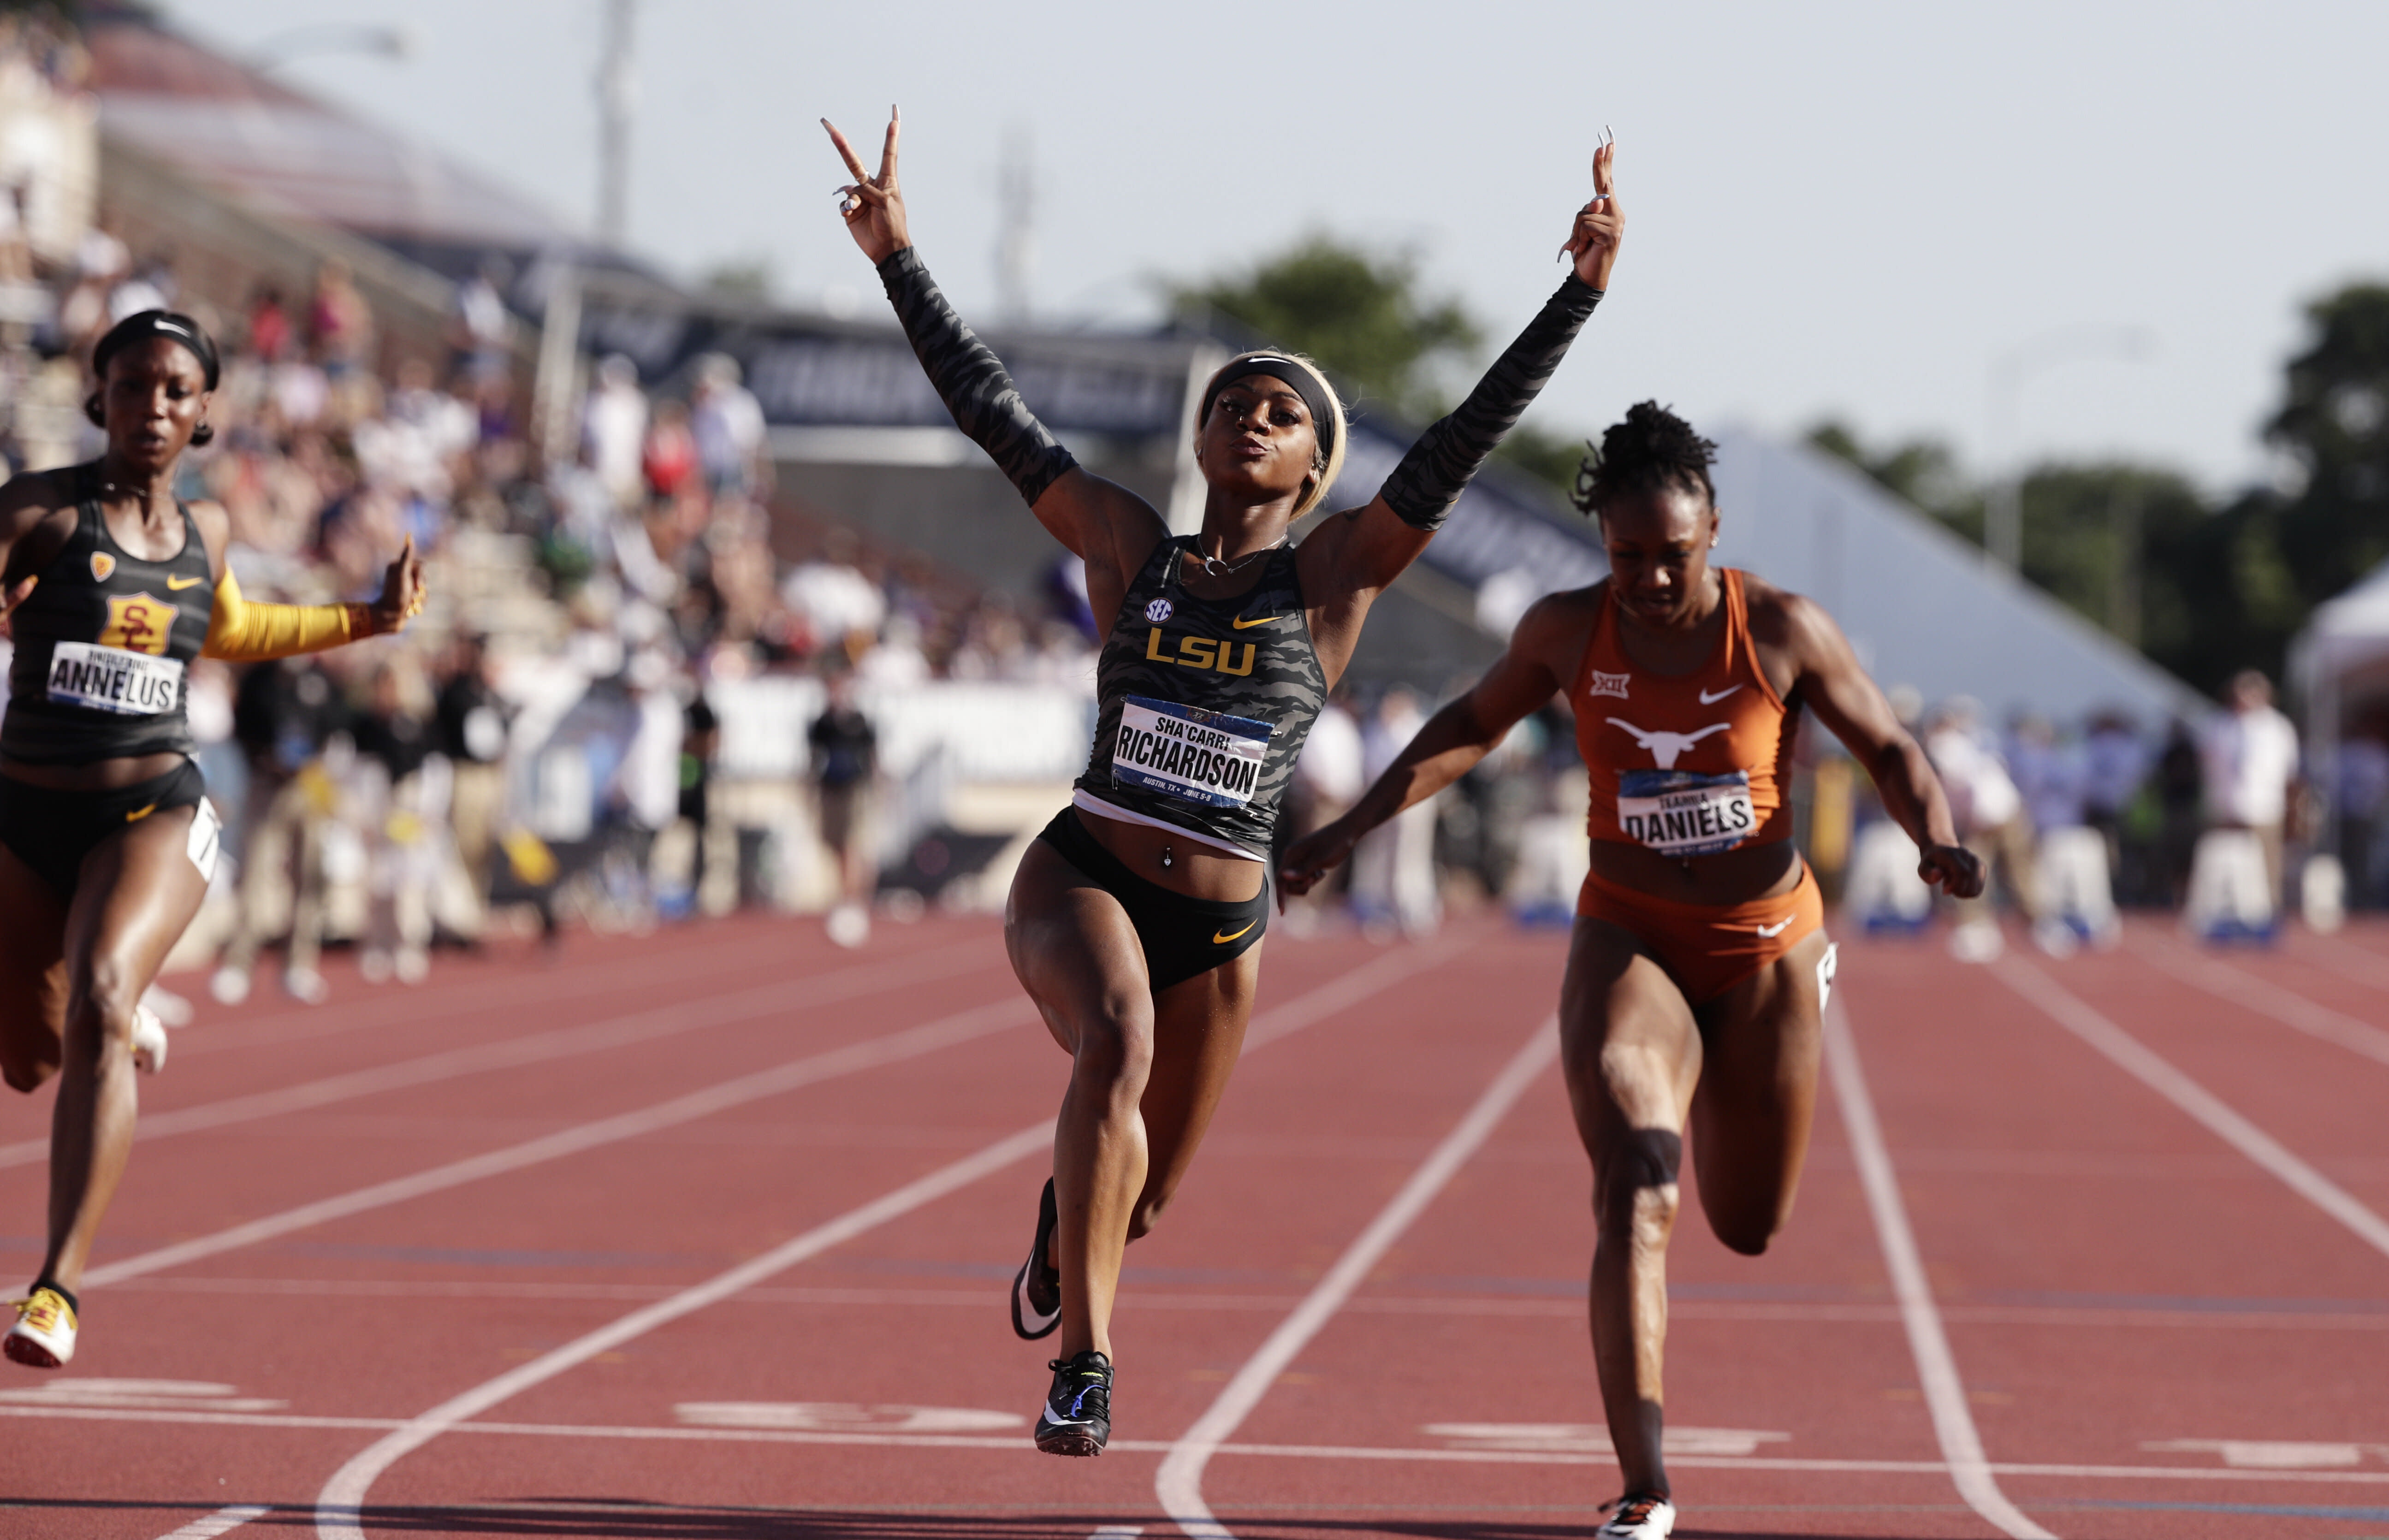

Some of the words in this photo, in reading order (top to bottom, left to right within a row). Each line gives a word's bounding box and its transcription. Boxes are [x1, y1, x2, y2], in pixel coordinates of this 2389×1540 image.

[1146, 599, 1172, 622] SEC
[1146, 627, 1256, 676] LSU
[53, 658, 171, 708] ANNELUS
[1156, 717, 1230, 751] SHA'CARRI
[1116, 725, 1257, 794] RICHARDSON
[1143, 776, 1166, 790] AUSTIN,
[1168, 783, 1176, 792] TX
[1183, 789, 1199, 799] JUNE
[1200, 793, 1212, 801] 5-8
[1626, 800, 1749, 842] DANIELS
